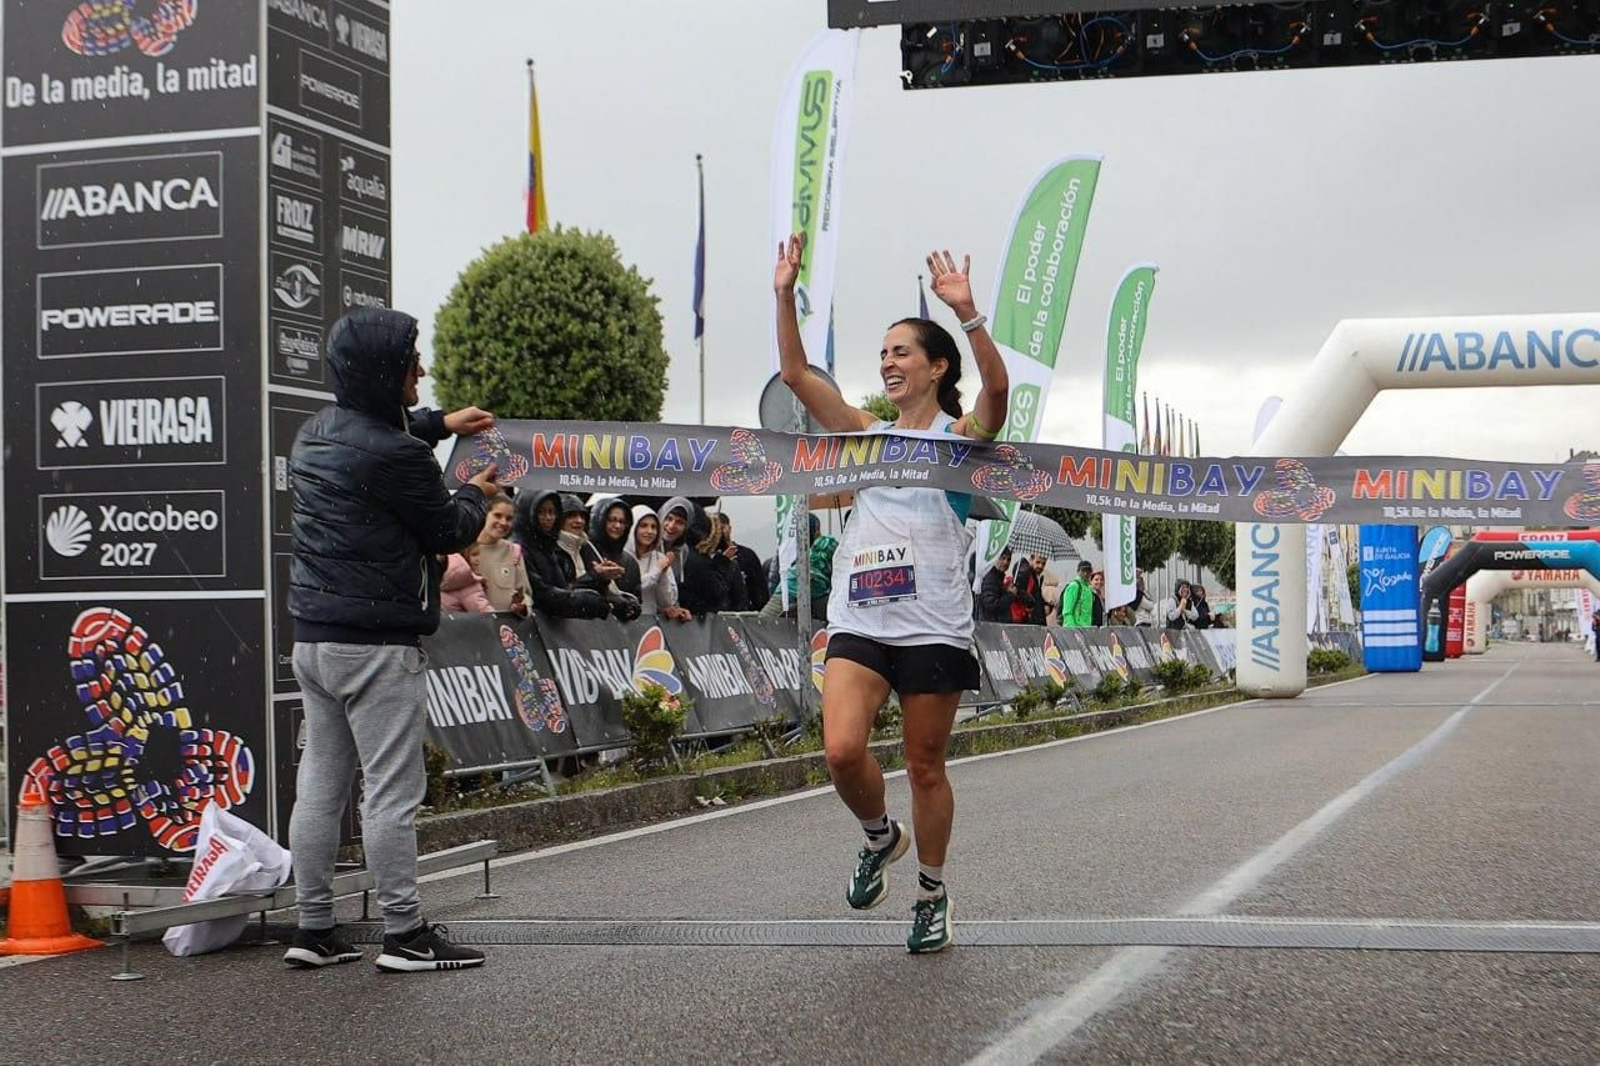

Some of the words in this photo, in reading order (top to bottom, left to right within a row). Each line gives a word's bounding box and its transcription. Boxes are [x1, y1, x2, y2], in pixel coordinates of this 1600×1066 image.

[5, 76, 36, 108] De
[42, 73, 65, 105] la
[71, 65, 151, 102] media,
[156, 62, 180, 94] la
[187, 54, 258, 92] mitad
[50, 177, 219, 221] ABANCA
[343, 225, 386, 260] MRW
[1022, 219, 1048, 278] poder
[1037, 177, 1081, 306] colaboración
[1016, 283, 1031, 306] El
[1032, 309, 1048, 330] la
[1027, 330, 1042, 357] de
[1118, 316, 1127, 365] poder
[1115, 367, 1123, 382] El
[100, 397, 213, 446] VIEIRASA
[532, 432, 718, 472] MINIBAY
[791, 436, 973, 473] MINIBAY
[559, 474, 582, 488] 10,5k
[583, 475, 596, 487] De
[597, 475, 607, 487] la
[608, 475, 638, 489] Media,
[639, 476, 649, 488] la
[651, 476, 677, 489] Mitad
[814, 474, 836, 488] 10,5k
[836, 473, 848, 485] De
[849, 472, 858, 483] la
[858, 470, 887, 482] Media,
[889, 468, 899, 480] la
[901, 468, 930, 481] Mitad
[1056, 455, 1266, 497] MINIBAY
[1352, 469, 1565, 500] MINIBAY
[99, 503, 219, 532] Xacobeo
[1085, 494, 1112, 507] 10,5k
[1114, 496, 1127, 508] De
[1129, 498, 1140, 509] la
[1142, 500, 1176, 513] Media,
[1178, 501, 1189, 513] la
[1190, 502, 1220, 514] Mitad
[99, 543, 158, 567] 2027
[853, 547, 907, 567] MINIBAY
[1493, 549, 1571, 561] POWERADE
[859, 568, 905, 590] 10234
[1526, 569, 1581, 581] YAMAHA
